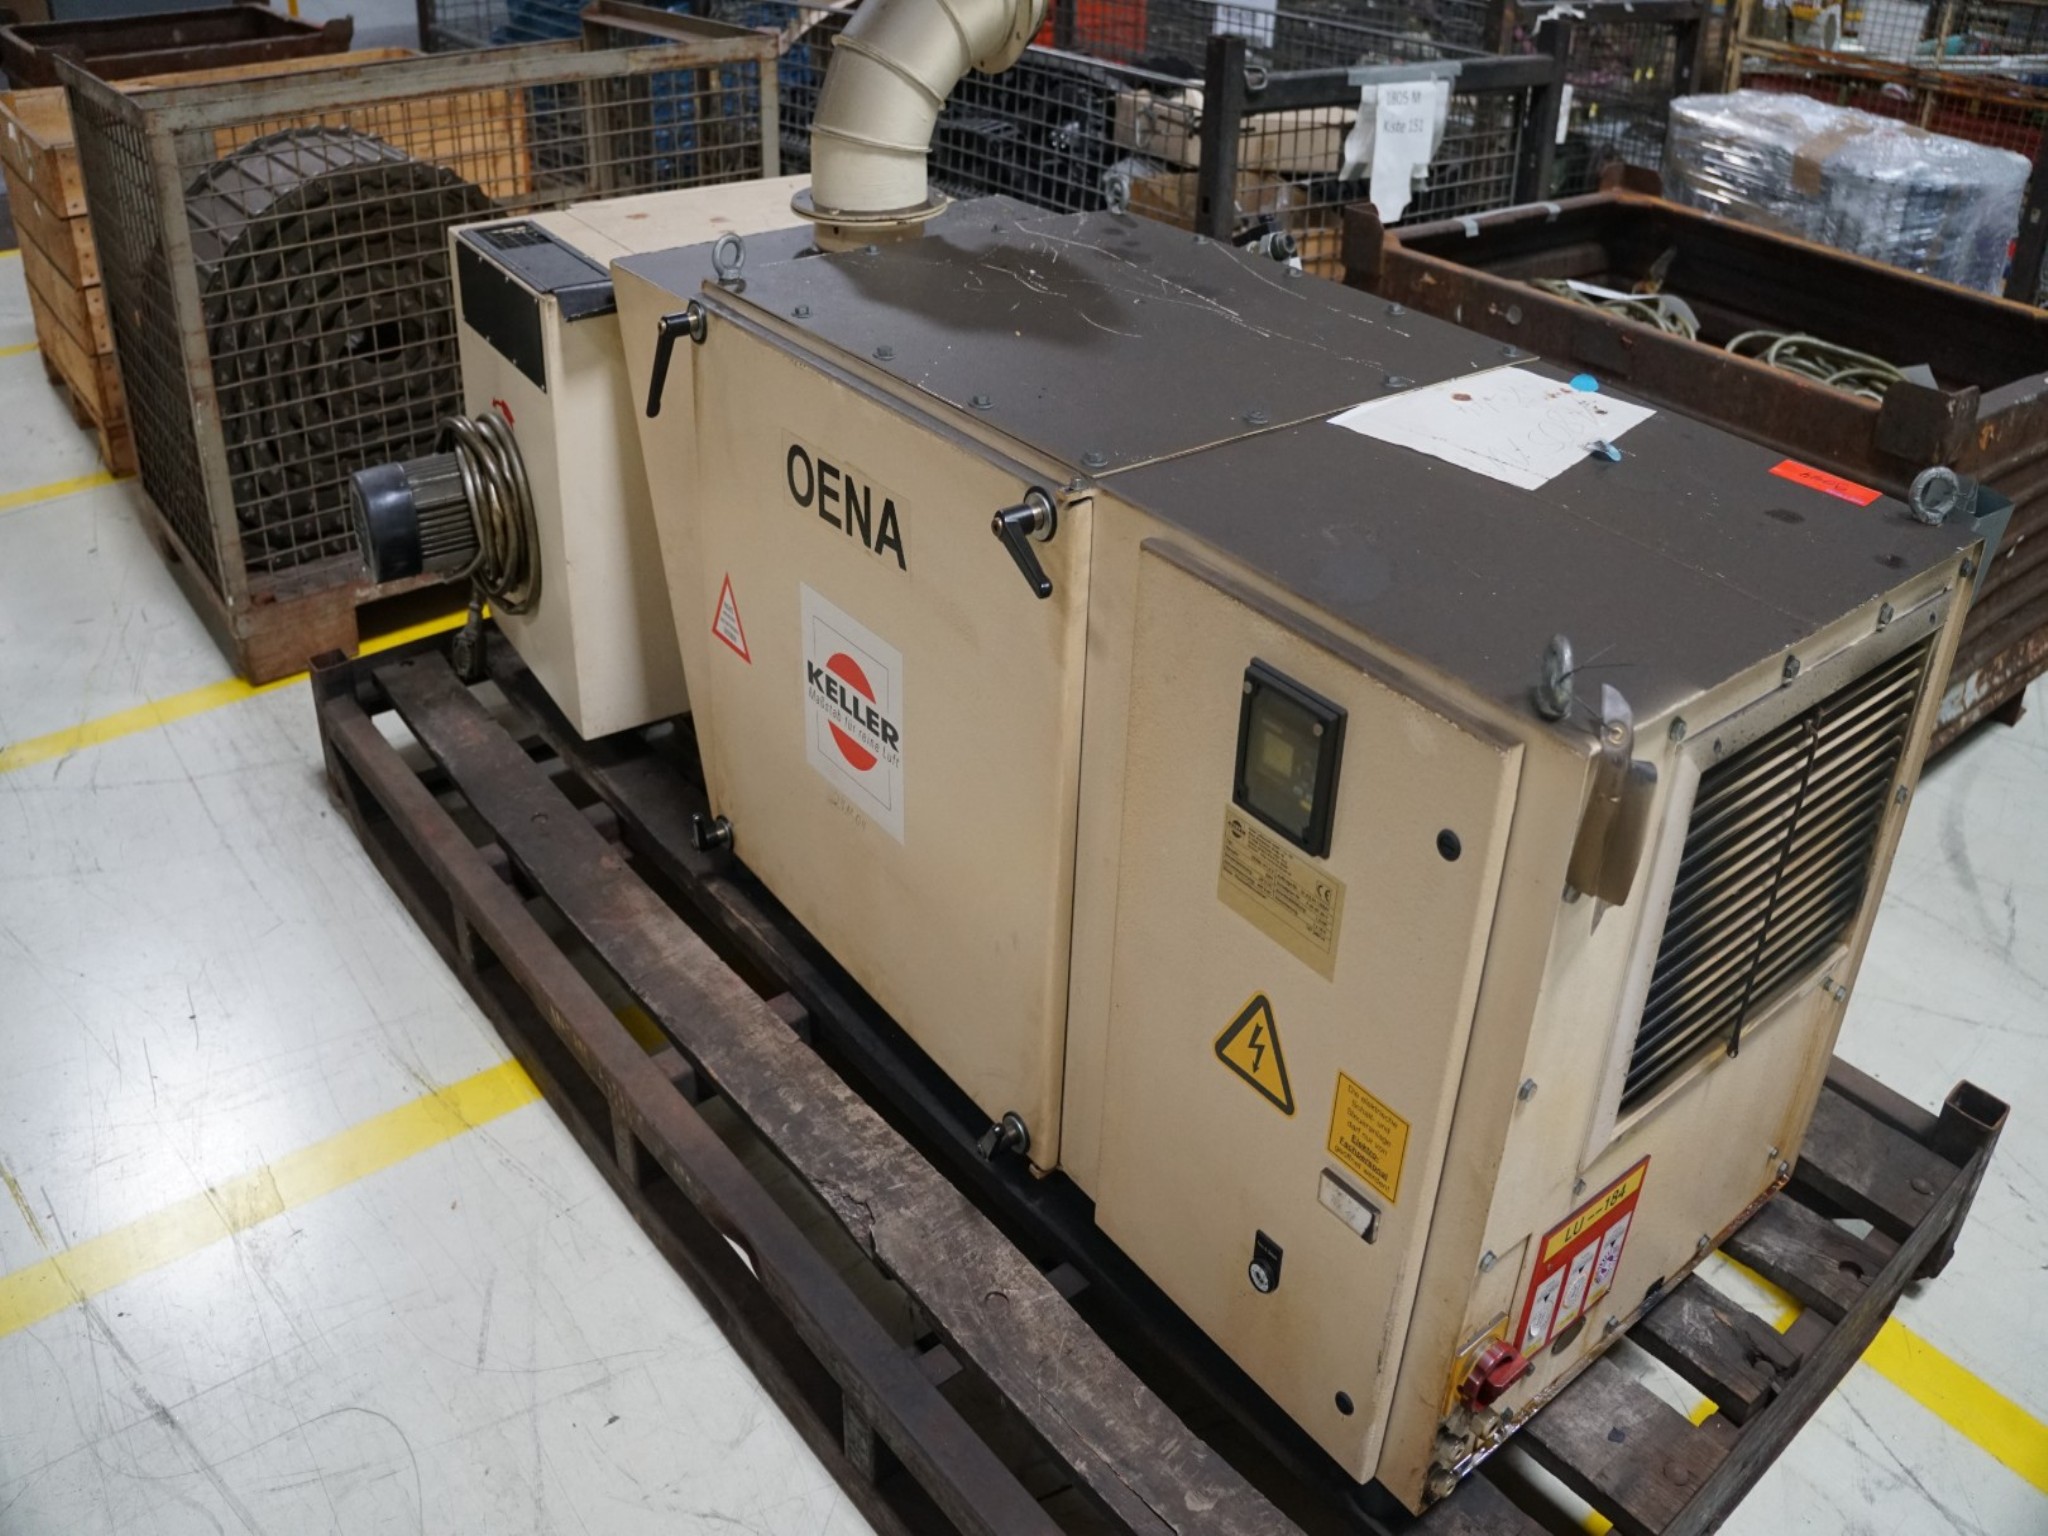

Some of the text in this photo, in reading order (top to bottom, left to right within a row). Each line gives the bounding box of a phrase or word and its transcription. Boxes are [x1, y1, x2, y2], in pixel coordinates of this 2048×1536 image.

[787, 444, 907, 572] OENA
[807, 660, 900, 753] KELLER
[808, 687, 900, 769] Maßstab für reine Luft
